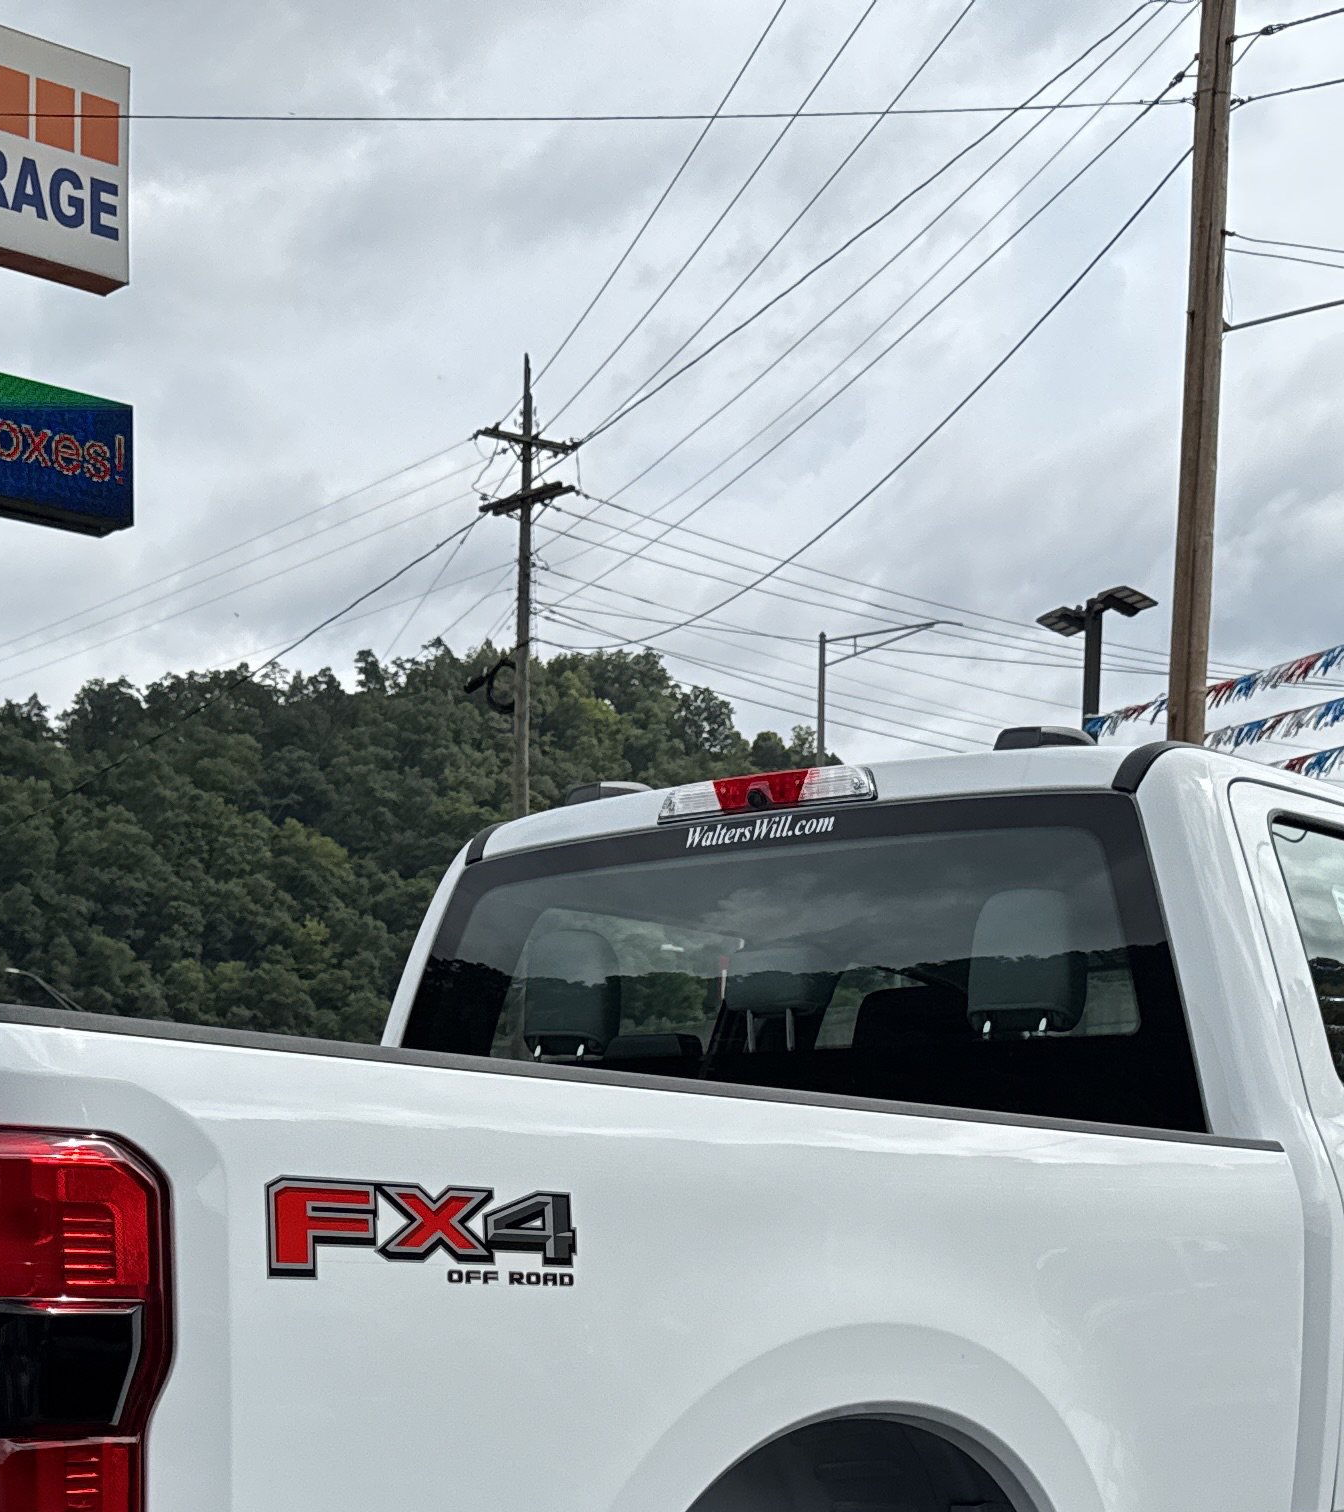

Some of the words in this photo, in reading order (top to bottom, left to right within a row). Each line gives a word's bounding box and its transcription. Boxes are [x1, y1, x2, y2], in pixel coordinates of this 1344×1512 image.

[685, 815, 835, 849] WaltersWill.com
[264, 1174, 577, 1280] FX4
[447, 1268, 499, 1285] OFF
[508, 1270, 574, 1287] ROAD
